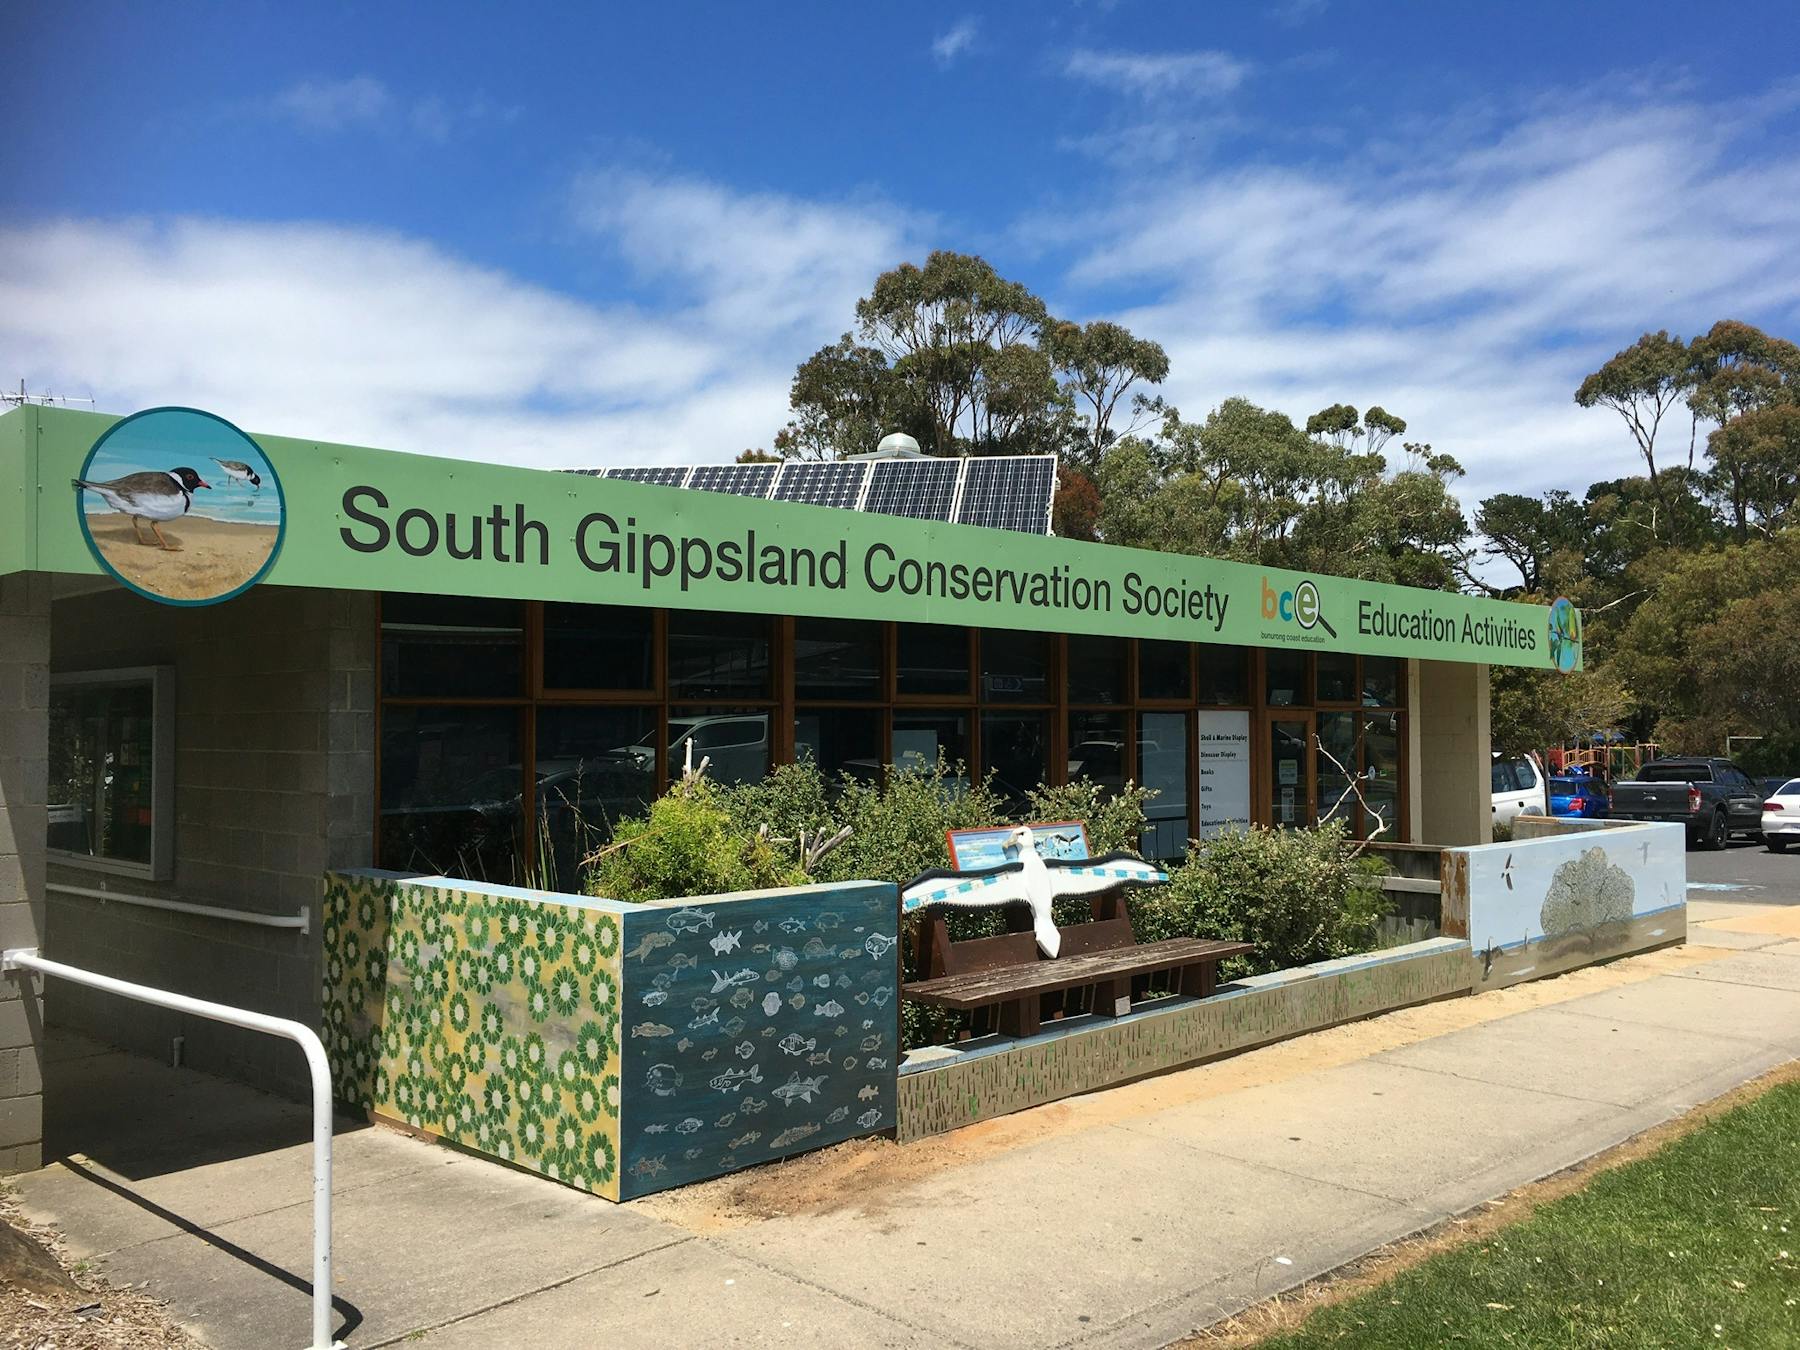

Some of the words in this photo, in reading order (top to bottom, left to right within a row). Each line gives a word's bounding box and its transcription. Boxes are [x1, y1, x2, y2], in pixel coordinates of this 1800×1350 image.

[338, 484, 549, 566] South
[575, 511, 847, 592] Gippsland
[864, 541, 1112, 613] Conservation
[1121, 571, 1230, 633] Society
[1262, 576, 1318, 624] bce
[1358, 600, 1456, 640] Education
[1461, 612, 1536, 651] Activities
[1260, 631, 1286, 643] bunurong
[1286, 634, 1301, 642] coast
[1301, 635, 1326, 644] education
[1232, 734, 1248, 743] Display
[1220, 751, 1237, 759] Display
[1201, 803, 1212, 811] Toys
[1201, 819, 1226, 827] Educational
